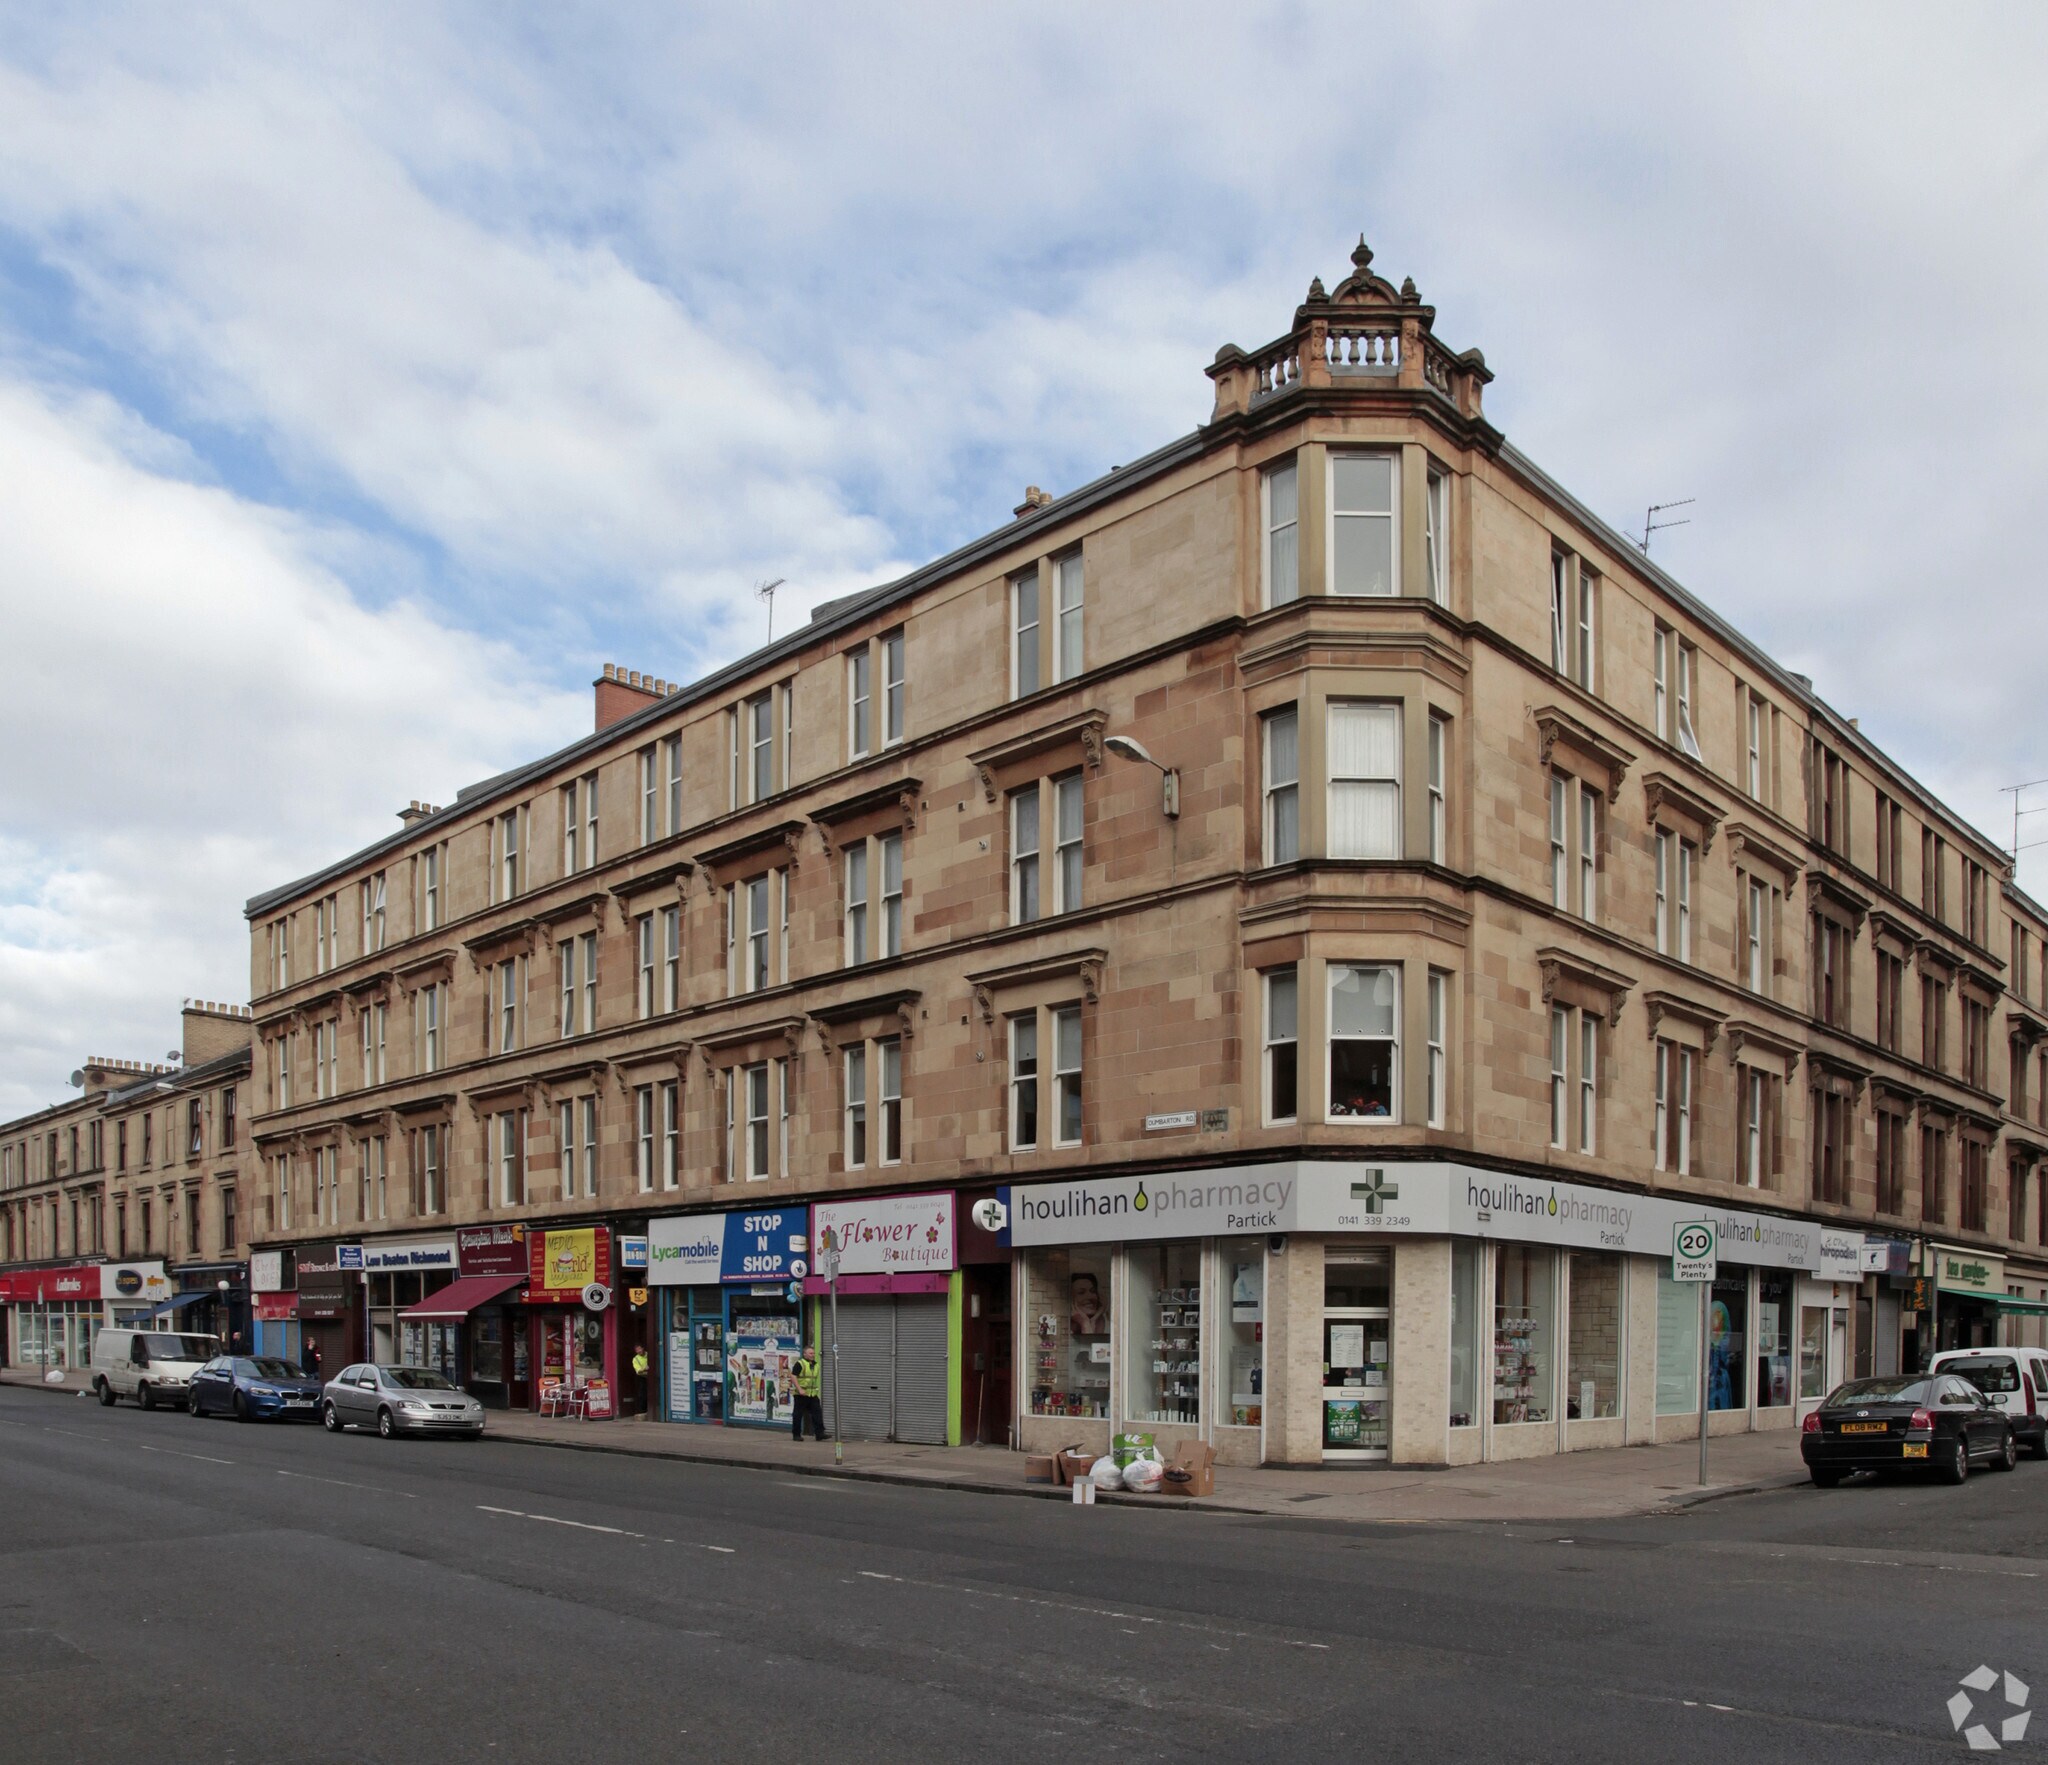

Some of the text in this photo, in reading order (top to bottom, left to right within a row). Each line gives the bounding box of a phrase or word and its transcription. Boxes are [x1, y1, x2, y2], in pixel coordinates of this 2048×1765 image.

[1148, 1116, 1182, 1126] DUMBARTON
[1185, 1114, 1194, 1123] RD
[1021, 1180, 1292, 1220] houlihan pharmacy
[1467, 1177, 1633, 1236] houlihan pharmacy
[744, 1214, 782, 1233] STOP
[819, 1210, 837, 1223] The
[1227, 1211, 1277, 1229] Partick
[1338, 1216, 1410, 1226] 0141 339 2349
[757, 1235, 768, 1251] N
[1600, 1230, 1625, 1246] Partick
[1683, 1235, 1708, 1249] 20
[1762, 1223, 1810, 1254] pharmacy
[366, 1254, 381, 1267] Low
[382, 1253, 409, 1267] Beaton
[410, 1250, 450, 1265] Richmond
[652, 1241, 719, 1262] Lycamobile
[882, 1247, 949, 1266] Boutique
[1820, 1244, 1857, 1261] hiropodist
[743, 1254, 782, 1272] SHOP
[1677, 1262, 1712, 1270] Twenty's
[1844, 1423, 1865, 1432] FL08
